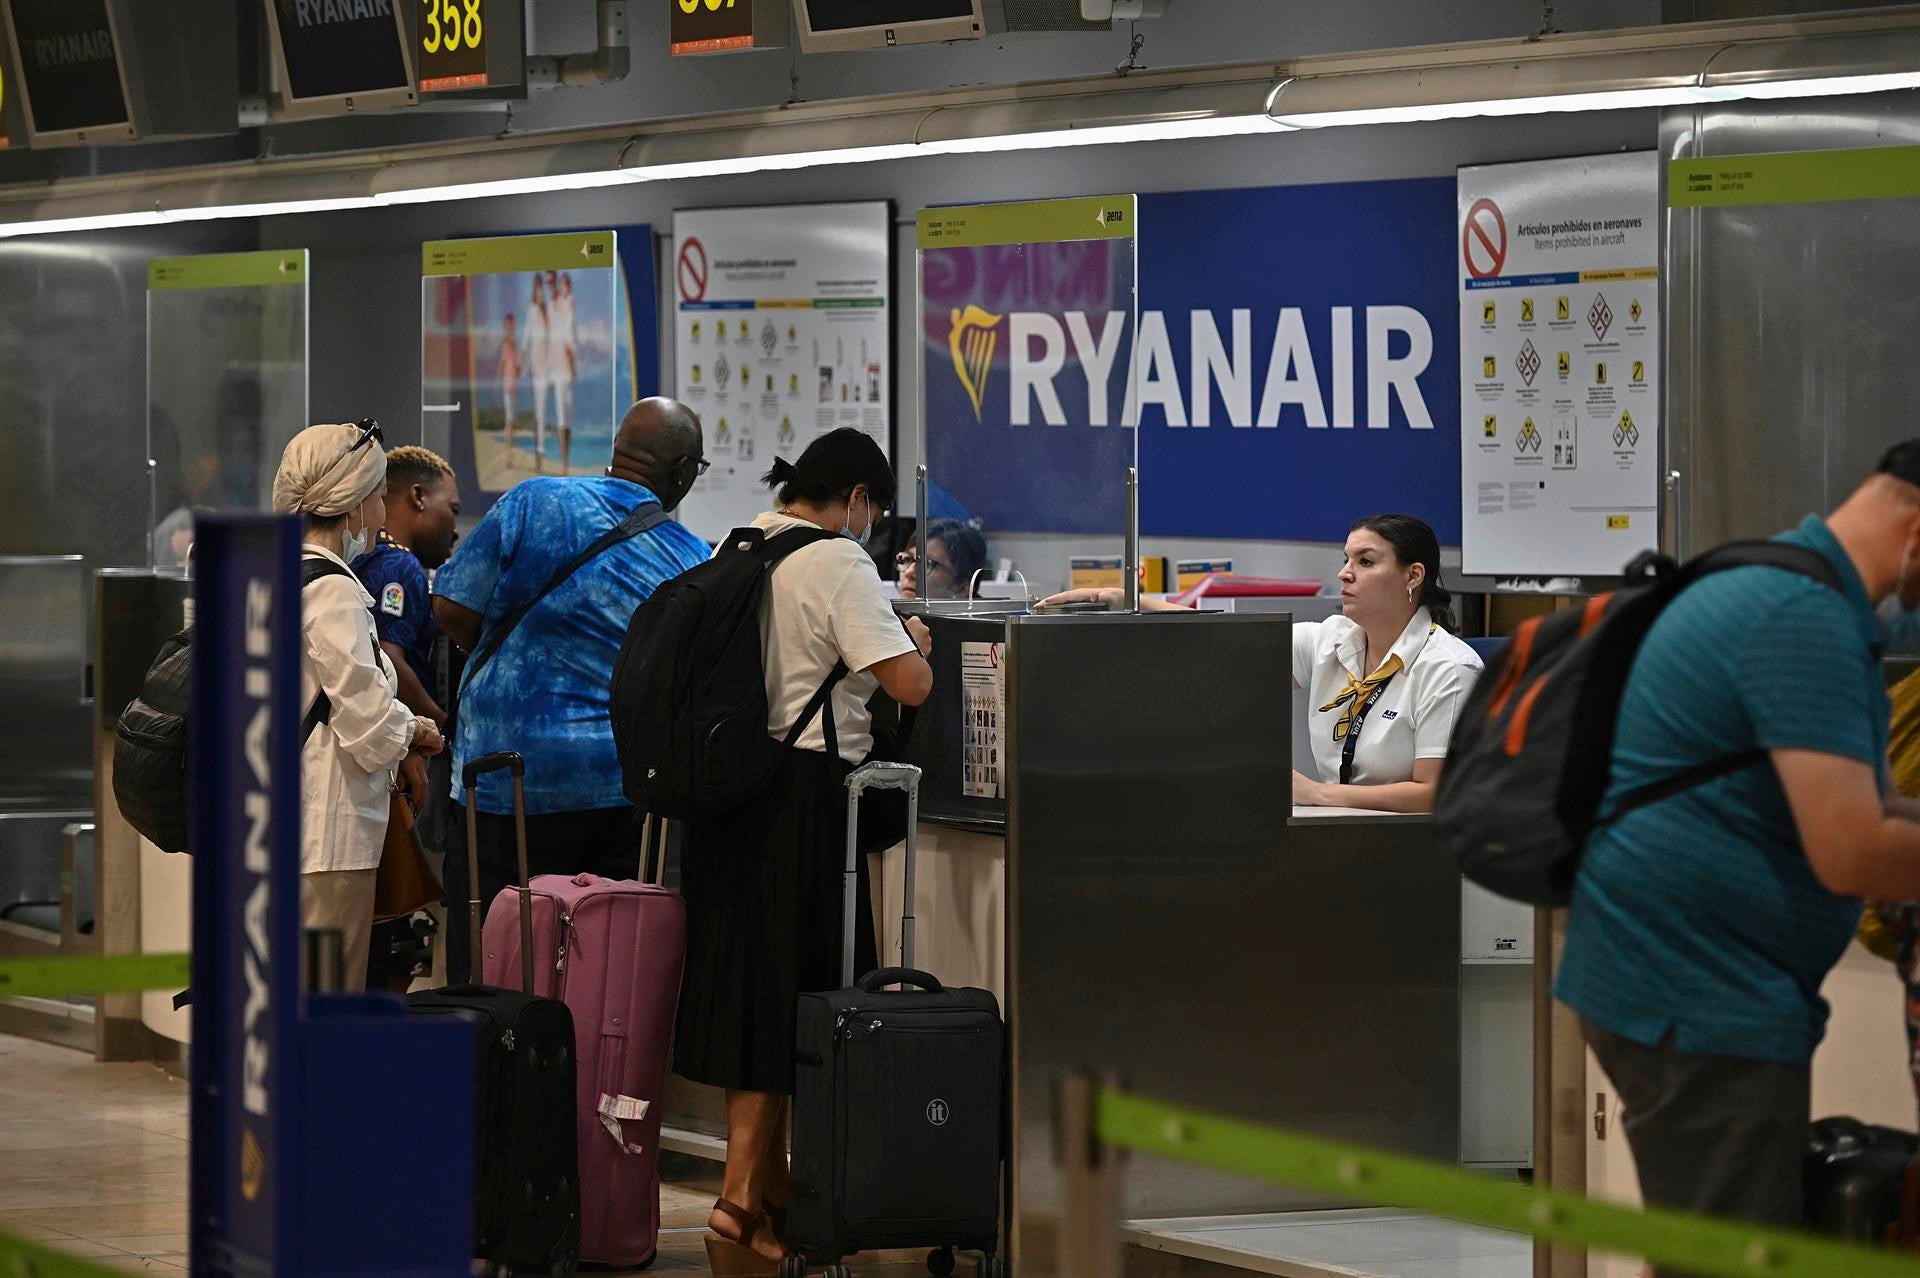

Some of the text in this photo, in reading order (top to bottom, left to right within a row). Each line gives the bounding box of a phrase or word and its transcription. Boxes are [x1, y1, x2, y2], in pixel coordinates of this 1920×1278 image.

[422, 0, 482, 53] 358
[35, 30, 112, 67] RYANAIR
[1106, 210, 1123, 222] aena
[1551, 219, 1592, 236] prohibidos
[1593, 220, 1603, 231] en
[1603, 217, 1642, 230] aeronaves
[1534, 231, 1625, 250] Items prohibited in aircraft
[1008, 304, 1435, 430] RYANAIR
[1367, 686, 1383, 705] AZUL
[1352, 715, 1364, 736] AZUL
[243, 578, 272, 1117] RYANAIR
[931, 1103, 945, 1121] it
